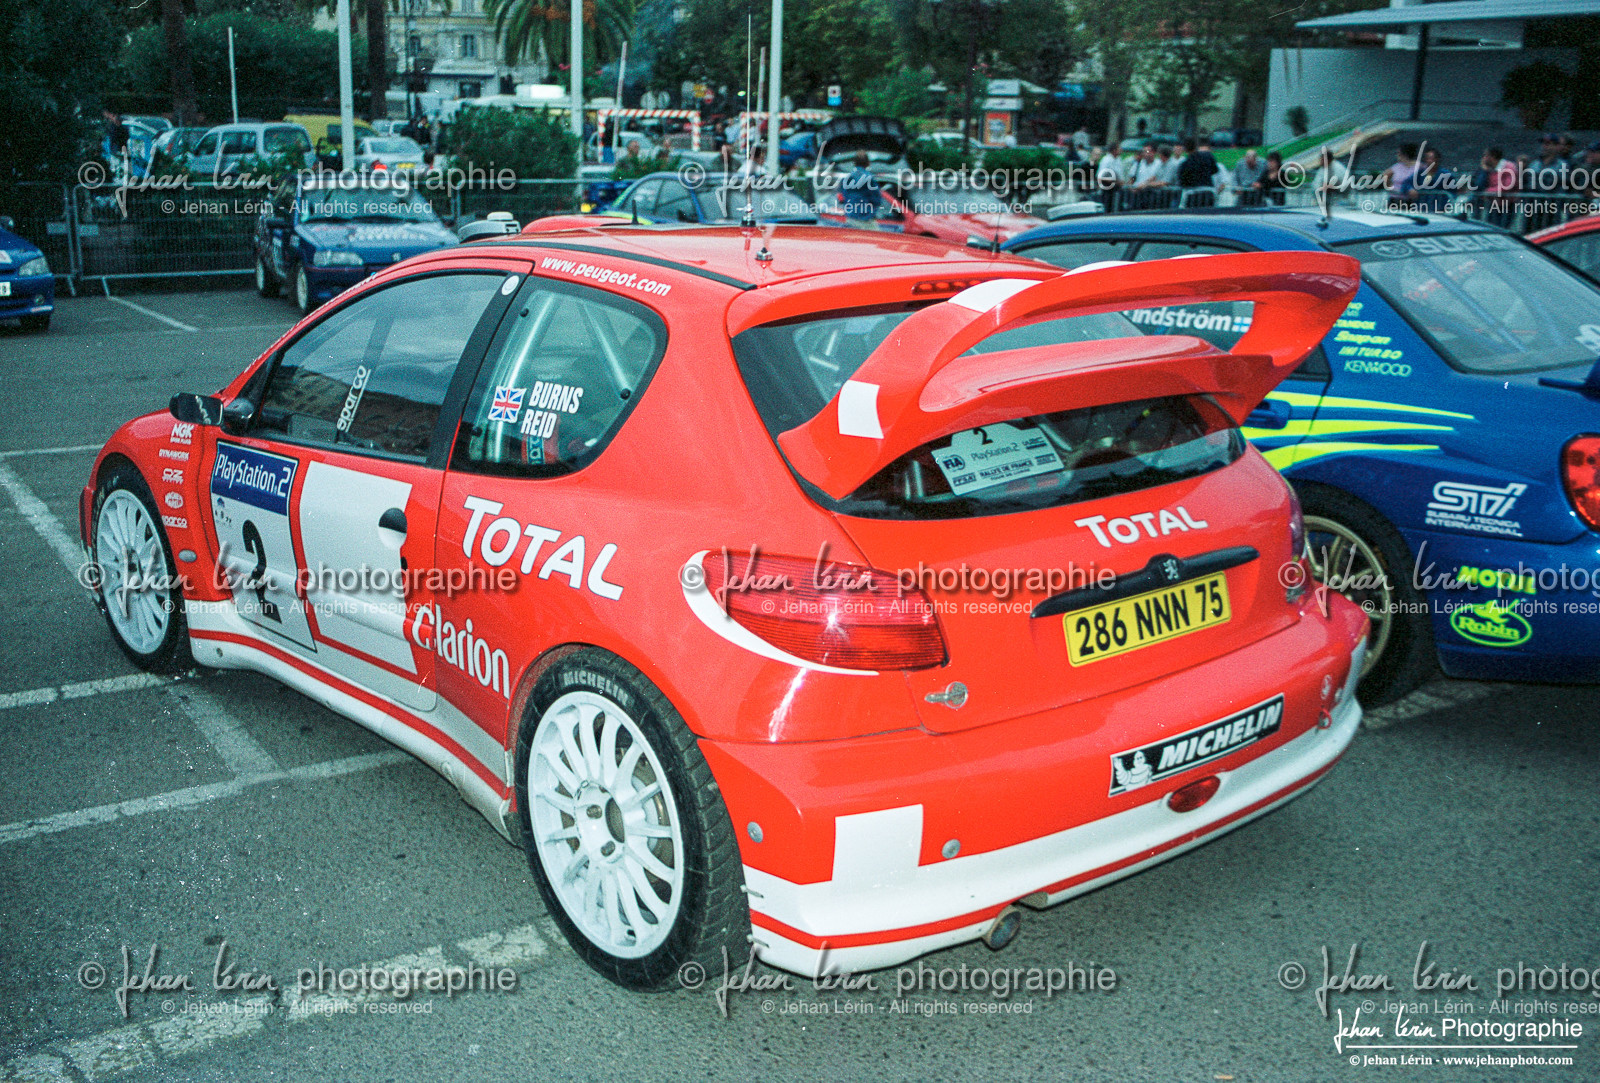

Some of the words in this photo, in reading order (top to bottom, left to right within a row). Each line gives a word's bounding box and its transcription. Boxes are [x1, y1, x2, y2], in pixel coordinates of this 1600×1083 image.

[541, 257, 671, 296] www.peugeot.com
[1123, 306, 1232, 332] indström
[1344, 360, 1412, 377] KENWOOD
[336, 365, 368, 431] sparco
[529, 381, 583, 414] BURNS
[171, 423, 195, 438] NGK
[520, 409, 557, 439] REID
[973, 427, 993, 445] 2
[942, 456, 963, 470] FIA
[1074, 506, 1208, 548] TOTAL
[1425, 510, 1470, 524] SUBARU
[1471, 515, 1520, 529] TECNICA
[463, 495, 625, 601] TOTAL
[242, 519, 283, 624] 2
[1456, 565, 1537, 594] MOTUL
[1075, 607, 1128, 656] 286
[1134, 588, 1190, 640] NNN
[1195, 579, 1223, 622] 75
[1458, 616, 1520, 640] Robin
[412, 603, 510, 700] Clarion
[563, 669, 630, 707] MICHELIN
[1157, 703, 1282, 770] MICHELIN
